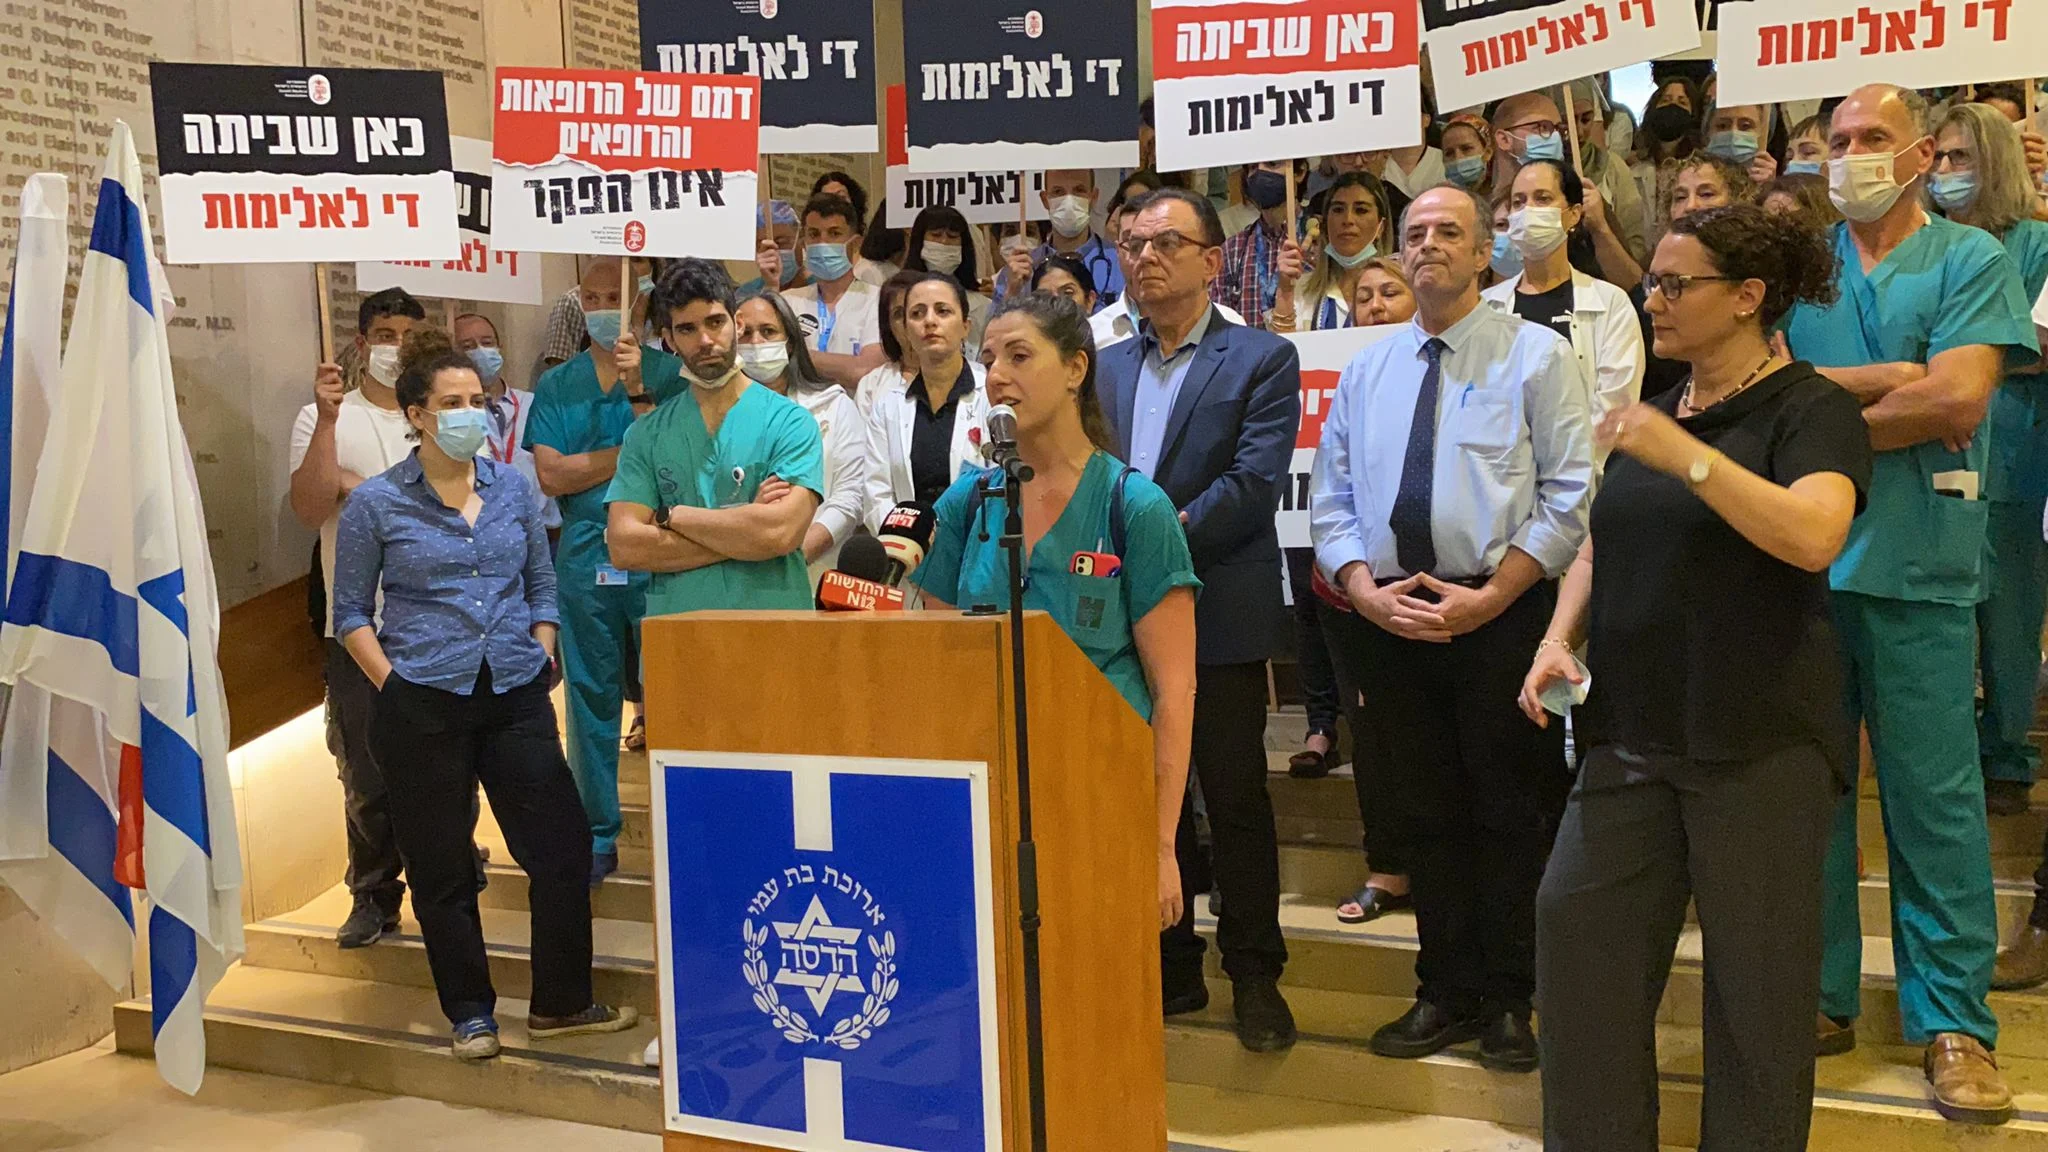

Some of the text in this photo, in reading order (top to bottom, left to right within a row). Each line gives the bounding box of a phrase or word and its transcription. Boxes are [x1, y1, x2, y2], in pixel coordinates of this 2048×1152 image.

[0, 22, 23, 38] nd
[6, 3, 37, 20] and
[1176, 11, 1395, 63] כאן שביתה
[1462, 0, 1656, 77] די לאלימות
[1757, 0, 2013, 67] די לאלימות
[7, 67, 39, 84] and
[656, 34, 859, 81] די לאלימות
[921, 53, 1122, 101] די לאלימות
[501, 76, 753, 120] דמם של הרופאות
[1188, 79, 1385, 136] די לאלימות
[6, 130, 37, 146] and
[183, 113, 425, 163] כאן שביתה
[559, 121, 692, 159] והרופאים
[11, 153, 43, 168] and
[202, 186, 370, 229] לאלימות
[383, 193, 420, 227] די
[524, 173, 633, 224] הפקר
[649, 168, 725, 211] אינו
[825, 572, 885, 598] החדשות
[847, 591, 876, 610] N12
[747, 864, 886, 927] ארוכת בת עמי
[781, 939, 858, 975] הדסה
